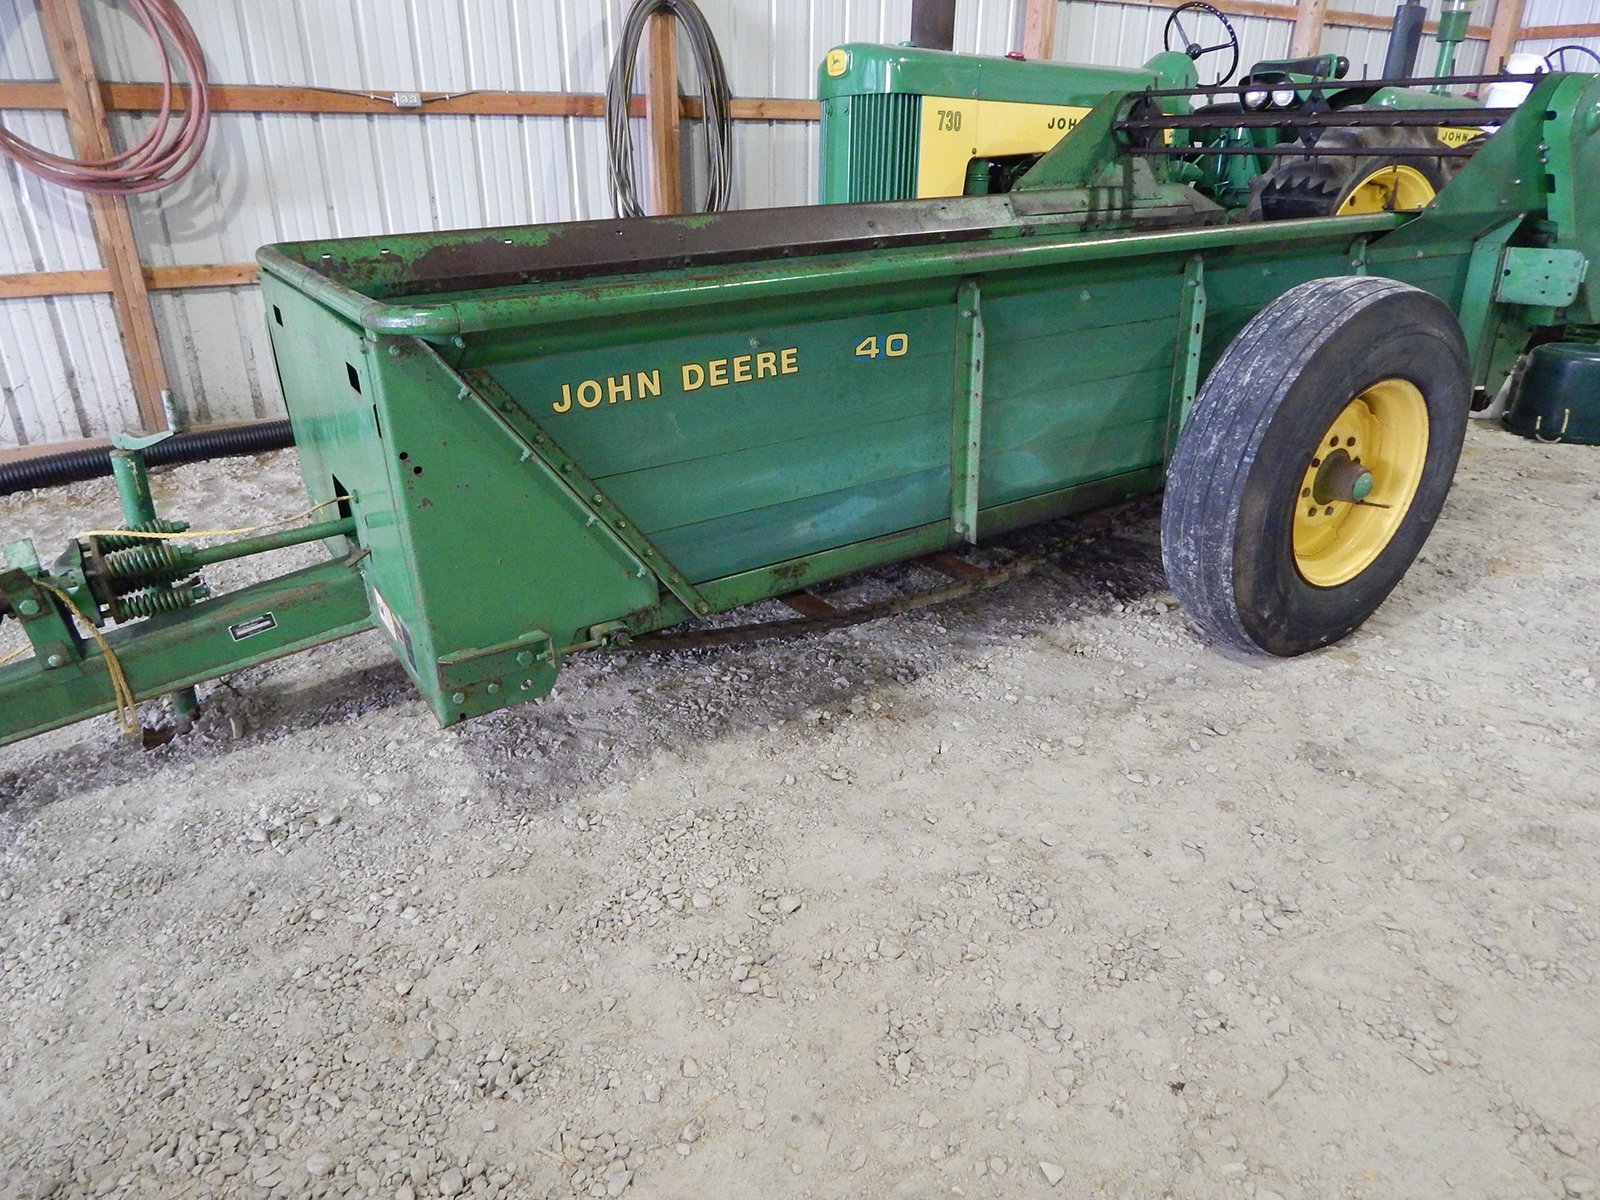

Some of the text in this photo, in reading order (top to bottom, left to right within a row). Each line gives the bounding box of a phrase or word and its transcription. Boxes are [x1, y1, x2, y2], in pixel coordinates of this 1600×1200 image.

[937, 110, 962, 132] 730
[1047, 117, 1077, 130] JOH
[1442, 131, 1468, 141] JOHN
[552, 333, 909, 413] JOHN DEERE 40
